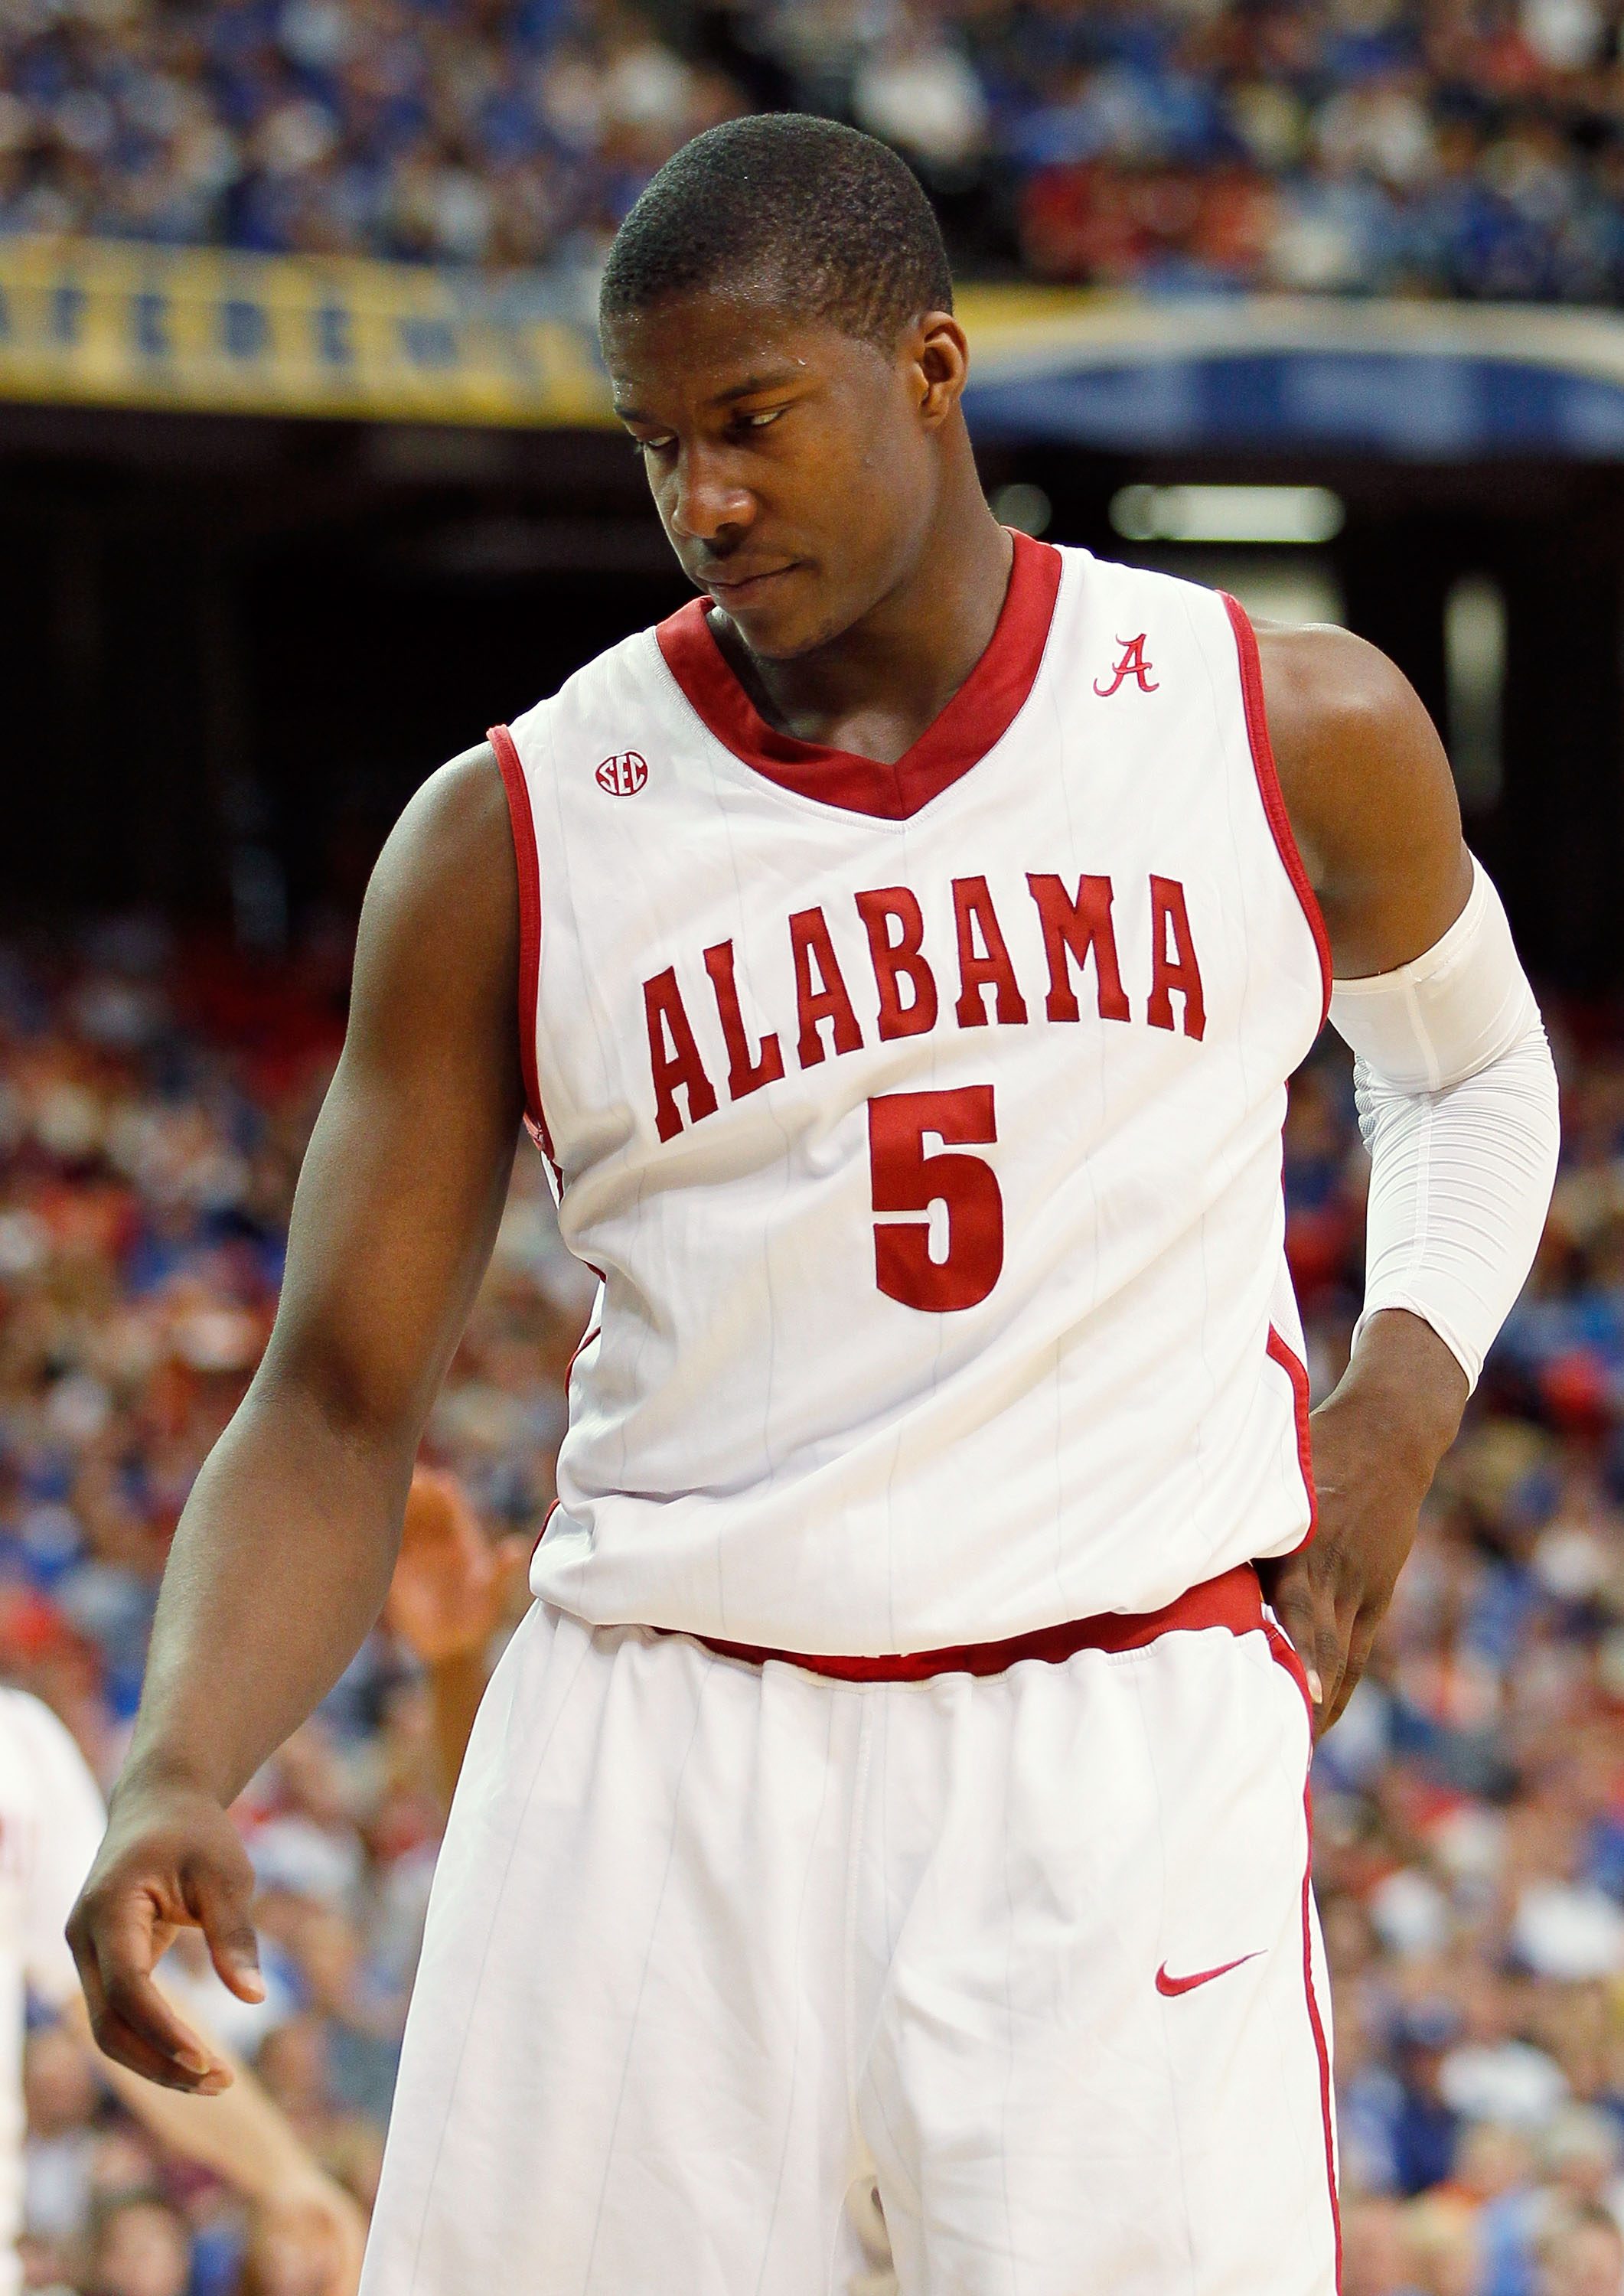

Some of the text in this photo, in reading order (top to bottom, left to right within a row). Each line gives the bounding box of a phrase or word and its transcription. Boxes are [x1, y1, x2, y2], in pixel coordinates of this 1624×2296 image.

[1093, 633, 1159, 697] A
[596, 752, 647, 795] SEC
[644, 874, 1207, 1143] ALABAMA
[868, 1085, 1004, 1313] 5
